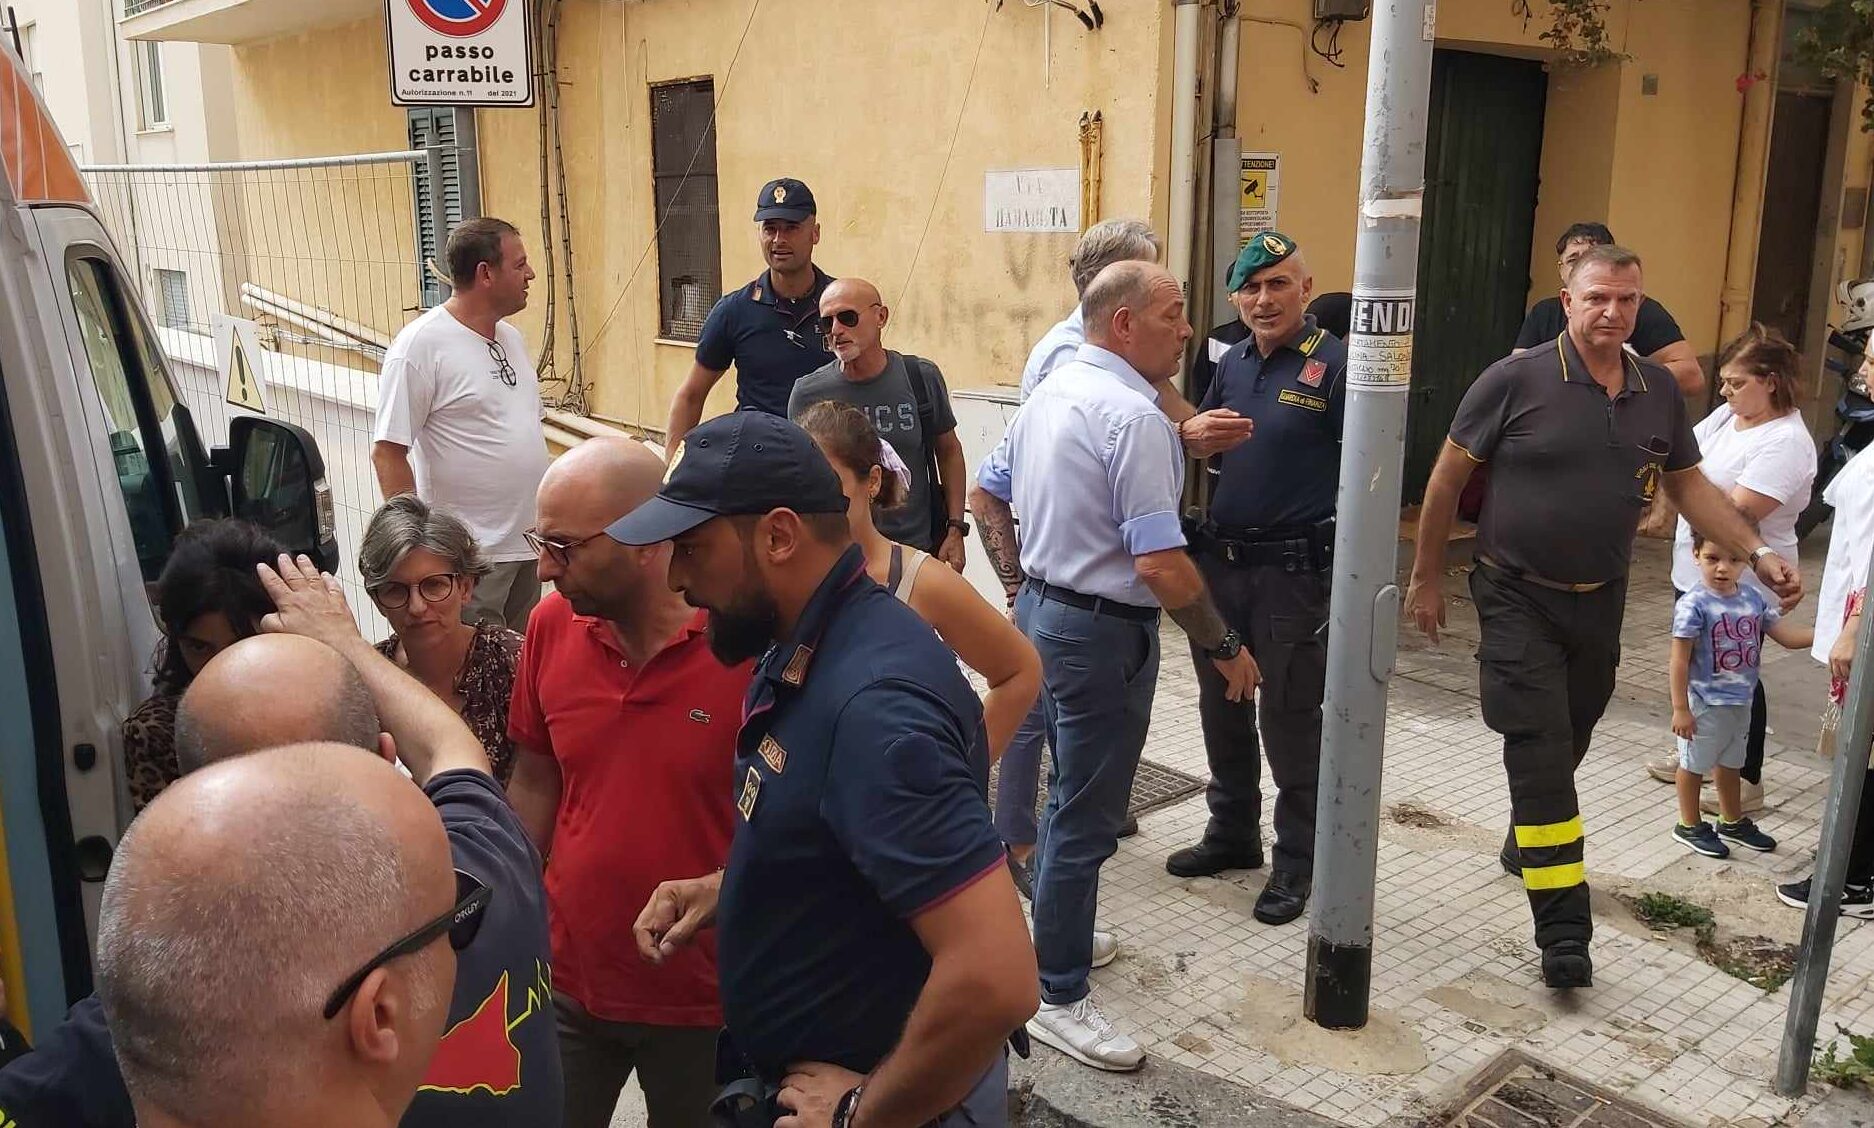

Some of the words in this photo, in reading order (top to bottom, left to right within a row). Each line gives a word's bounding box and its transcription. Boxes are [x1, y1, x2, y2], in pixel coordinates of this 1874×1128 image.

[425, 45, 494, 61] passo
[408, 65, 514, 83] carrabile
[401, 88, 456, 96] Autorizzazione
